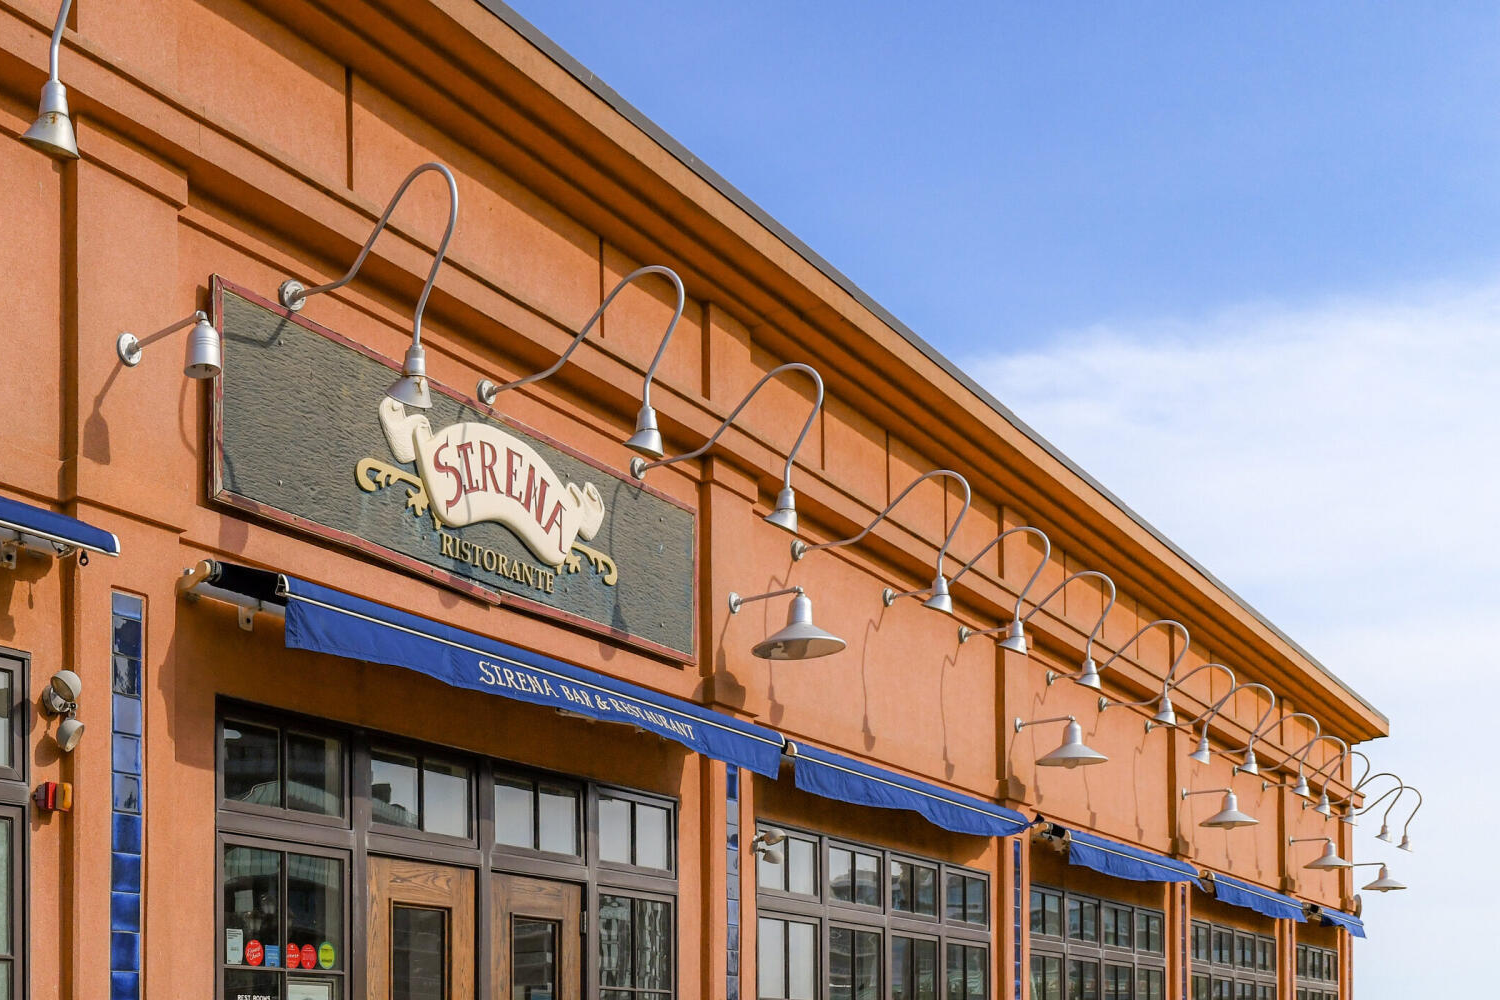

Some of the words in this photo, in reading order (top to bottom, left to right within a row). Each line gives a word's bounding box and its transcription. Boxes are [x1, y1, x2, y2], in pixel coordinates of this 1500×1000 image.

[433, 436, 567, 554] SIRENA
[439, 532, 555, 594] RISTORANTE
[478, 660, 559, 698] SIRENA
[559, 684, 595, 709] BAR
[595, 694, 611, 711] &
[608, 697, 696, 741] RESTAURANT
